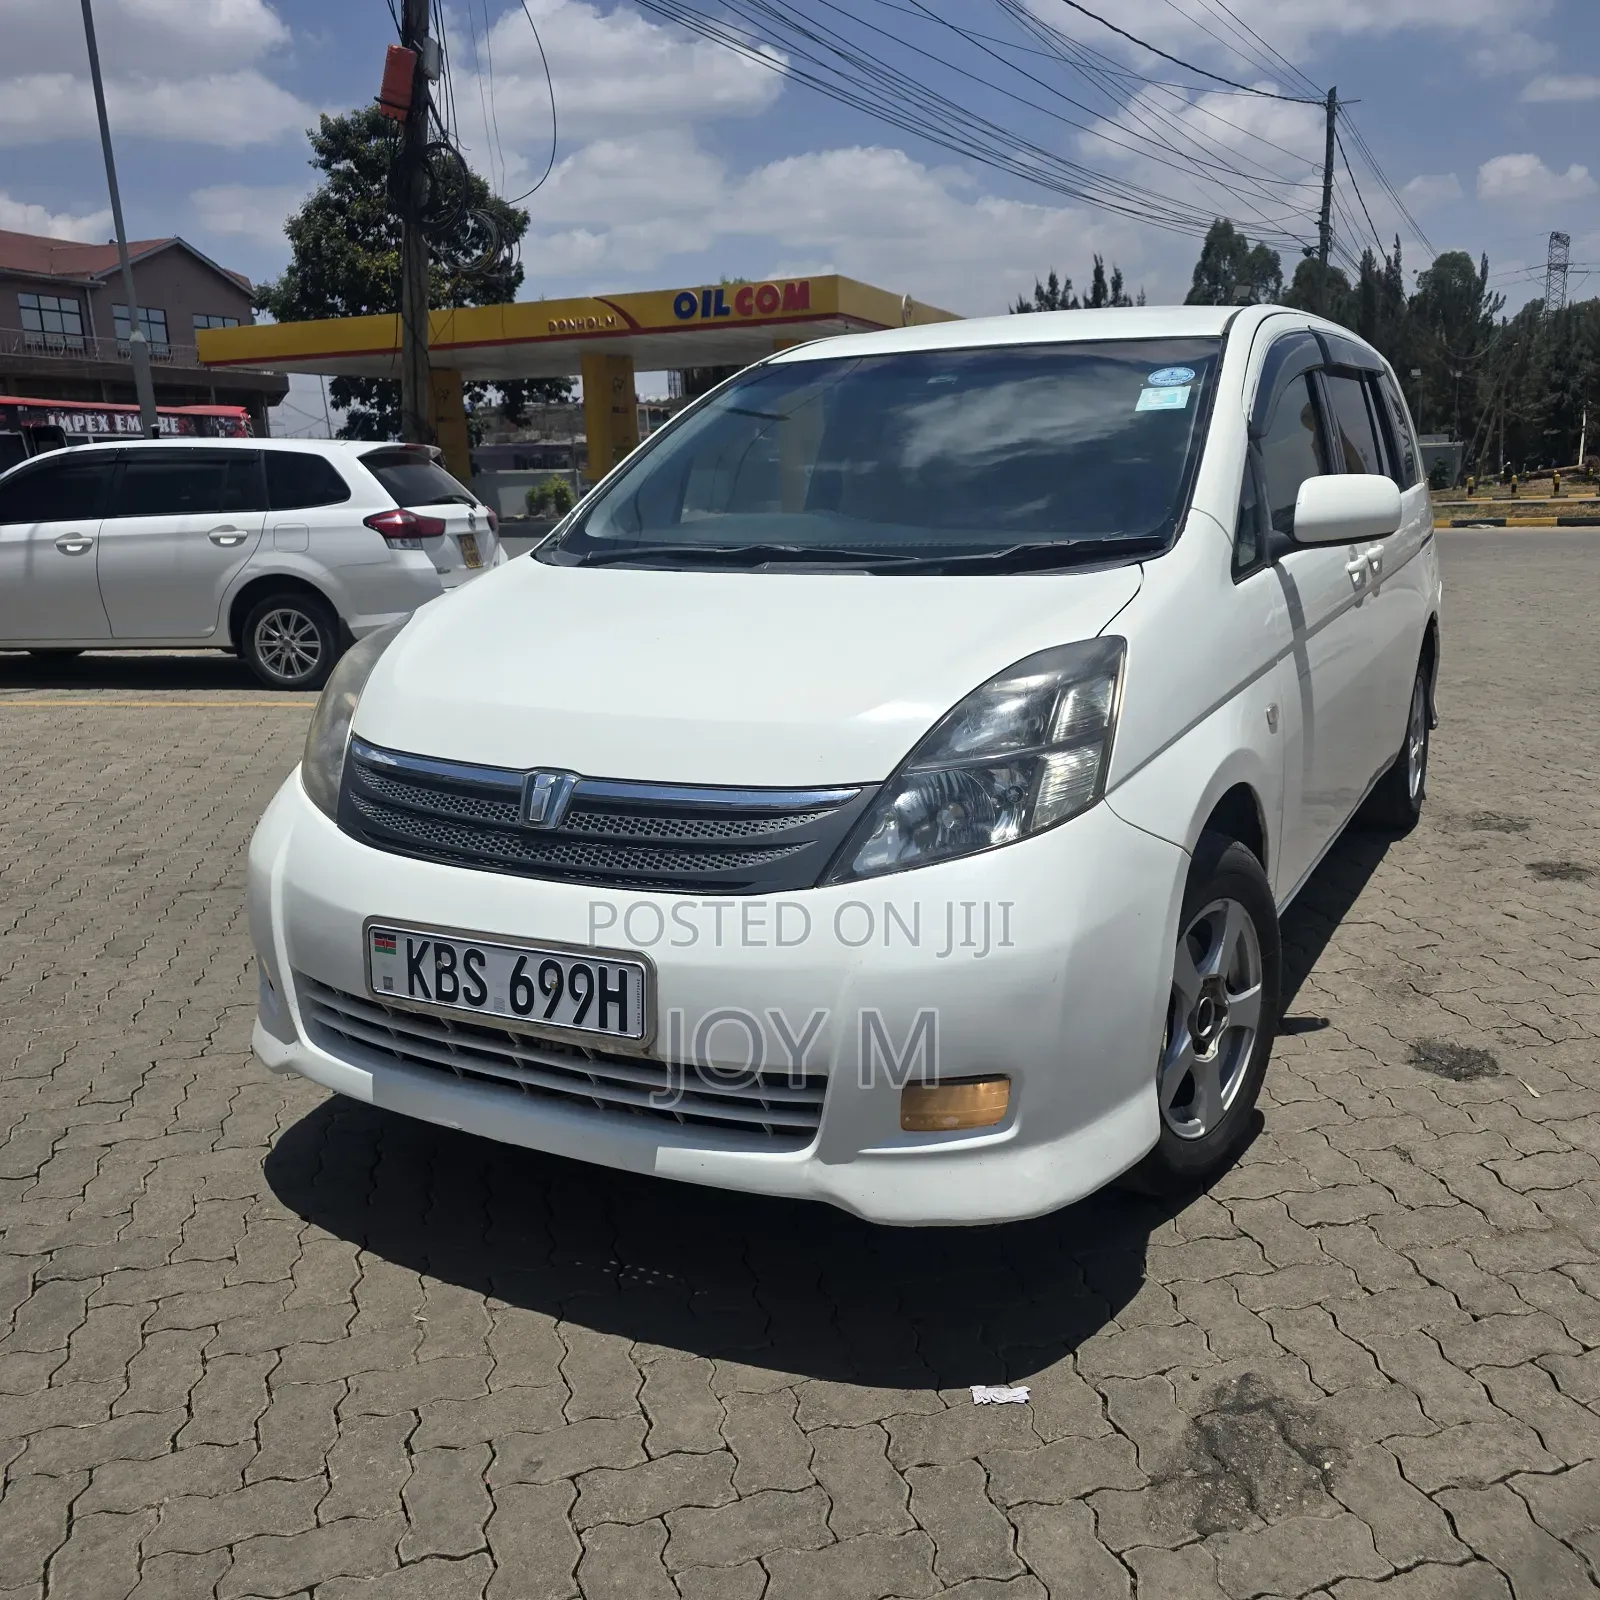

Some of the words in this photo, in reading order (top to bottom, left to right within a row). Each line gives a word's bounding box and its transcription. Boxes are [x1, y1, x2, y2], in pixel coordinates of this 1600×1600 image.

[673, 280, 811, 319] OILCOM
[548, 314, 617, 332] DONHOLM
[48, 412, 110, 433] IMPEX
[114, 413, 180, 433] EMRE
[406, 937, 488, 1007] KBS
[509, 954, 628, 1033] 699H
